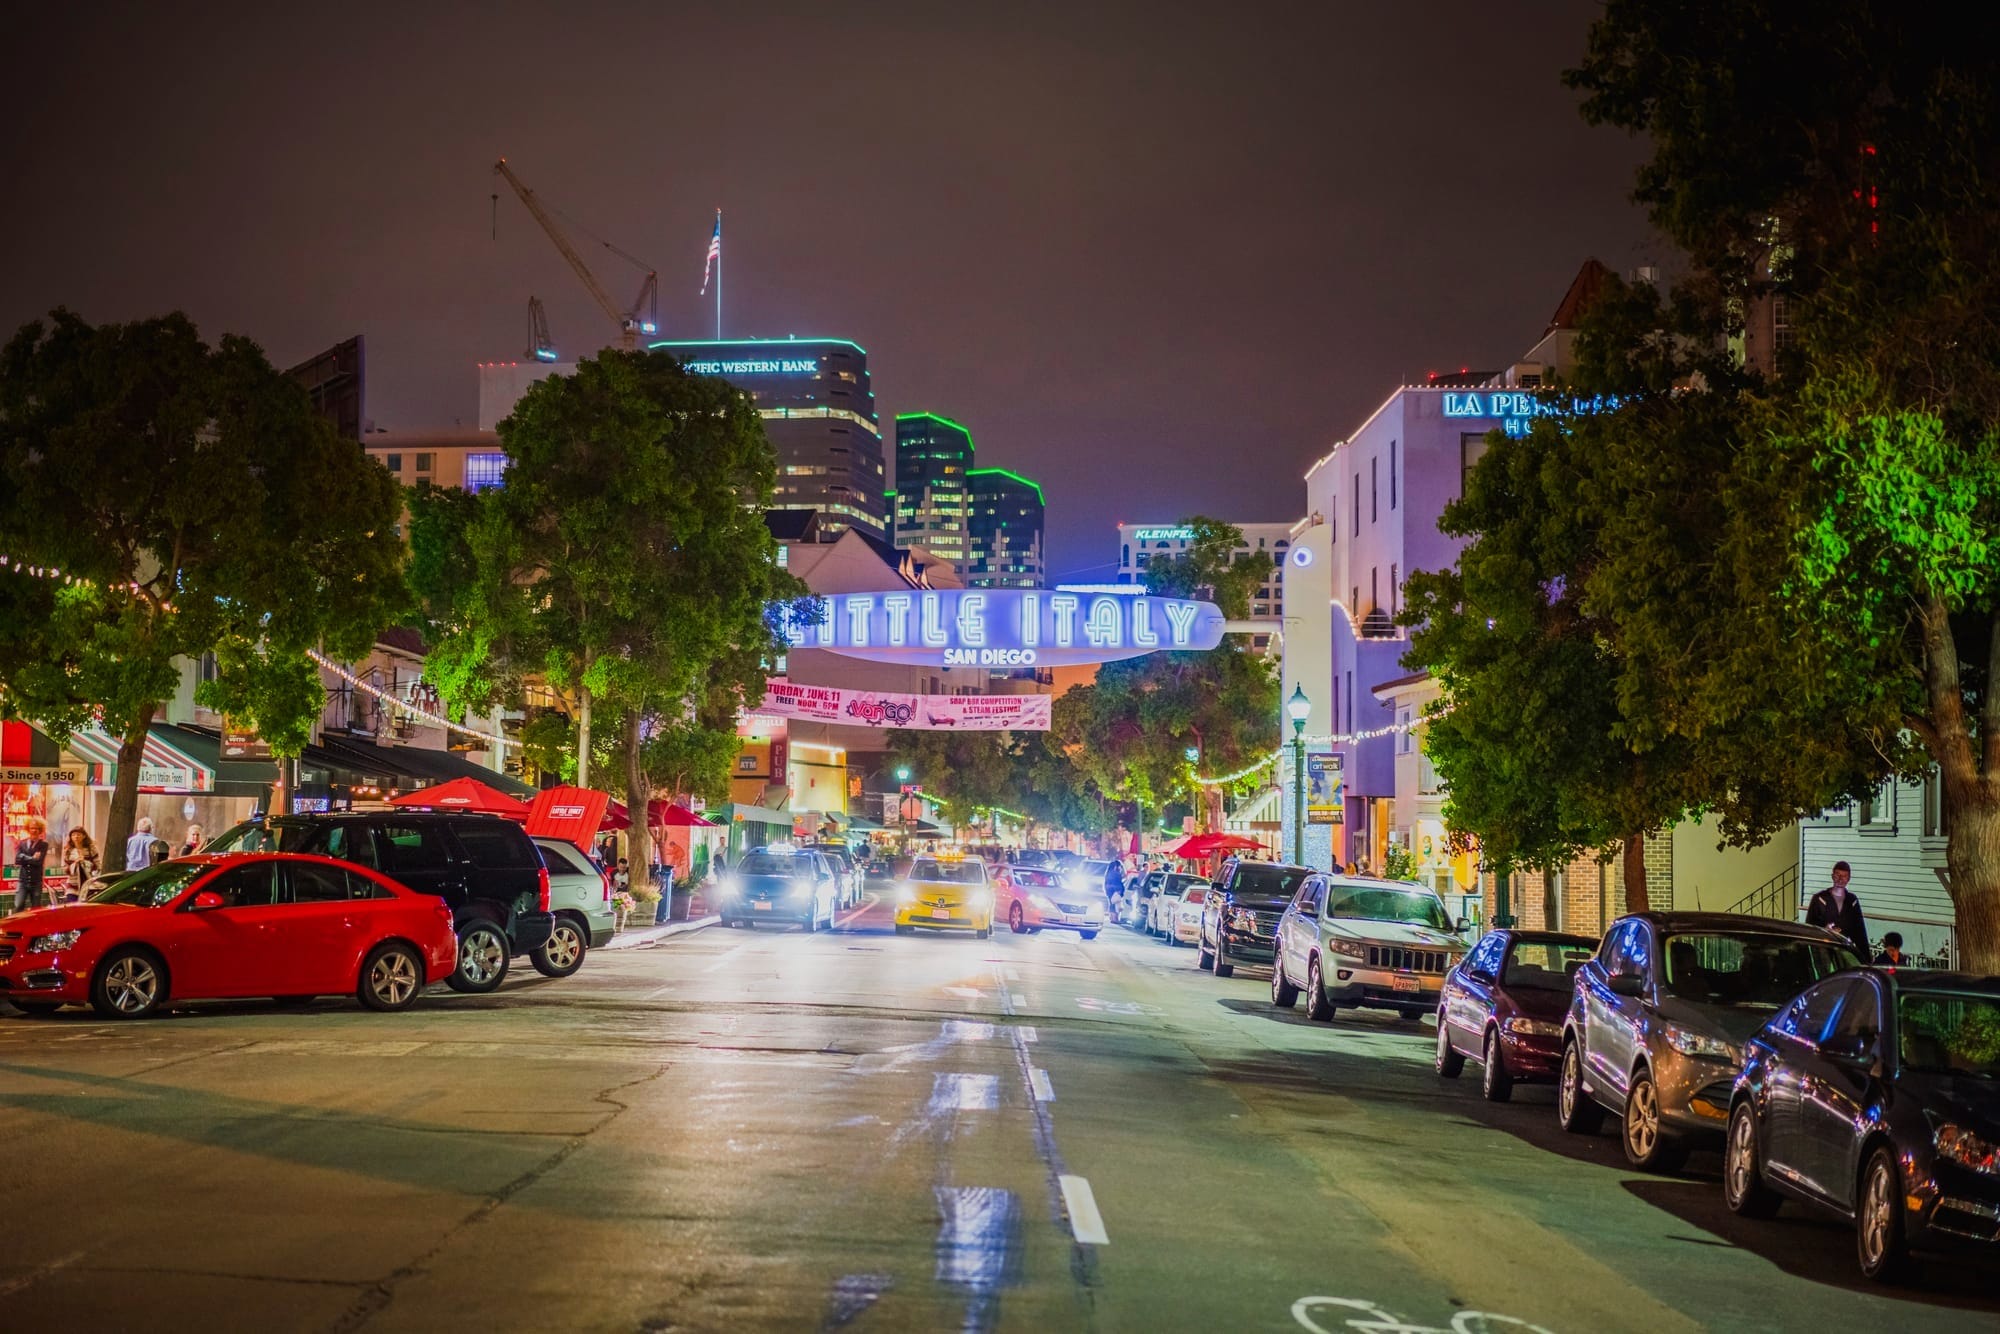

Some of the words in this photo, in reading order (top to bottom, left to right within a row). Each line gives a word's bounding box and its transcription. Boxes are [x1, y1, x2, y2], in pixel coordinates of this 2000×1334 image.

[685, 363, 720, 373] CIFIC
[722, 362, 779, 373] WESTERN
[782, 361, 817, 372] BANK
[1444, 394, 1482, 416] LA
[1023, 596, 1197, 644] ITALY
[944, 649, 977, 664] SAN
[981, 648, 1037, 664] DIEGO
[767, 683, 804, 698] TURDAY,
[807, 689, 829, 700] JUNE
[831, 691, 840, 701] 11
[776, 695, 795, 706] FREE!
[797, 699, 817, 709] NOON
[740, 761, 757, 769] ATM
[775, 745, 783, 778] PUB
[7, 770, 41, 781] Since
[46, 771, 75, 781] 1950
